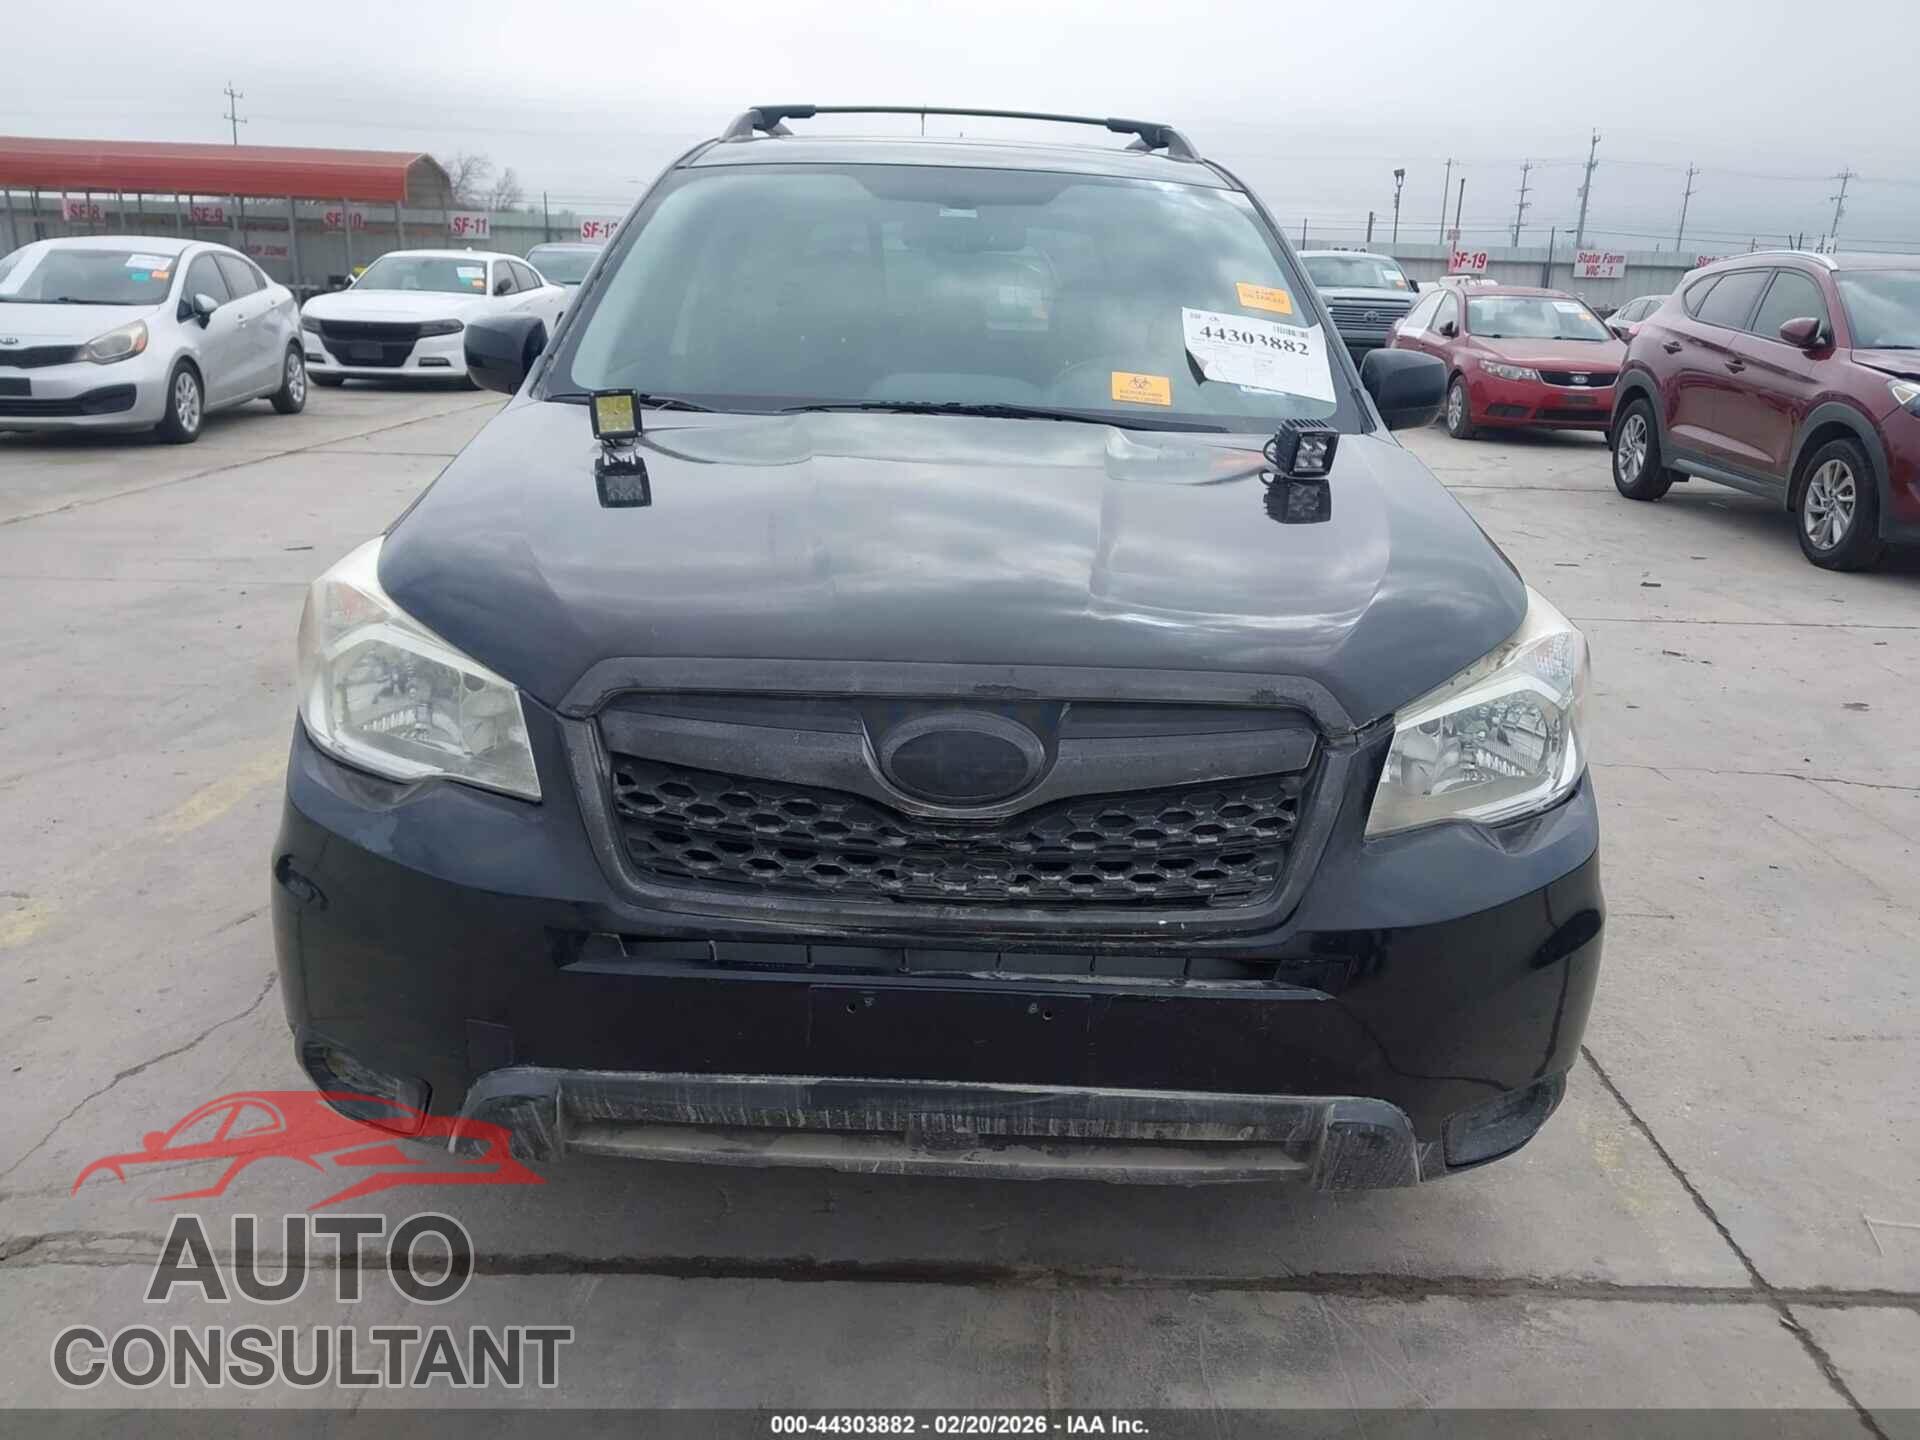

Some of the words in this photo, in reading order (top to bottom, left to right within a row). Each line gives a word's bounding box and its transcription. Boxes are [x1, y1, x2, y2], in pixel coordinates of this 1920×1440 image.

[325, 210, 363, 228] SF10
[453, 216, 488, 234] SF-11
[1453, 251, 1487, 269] SF-19
[1576, 252, 1600, 264] State
[1602, 253, 1625, 264] Farm
[1584, 265, 1599, 276] VIC
[1199, 325, 1310, 356] 44303882
